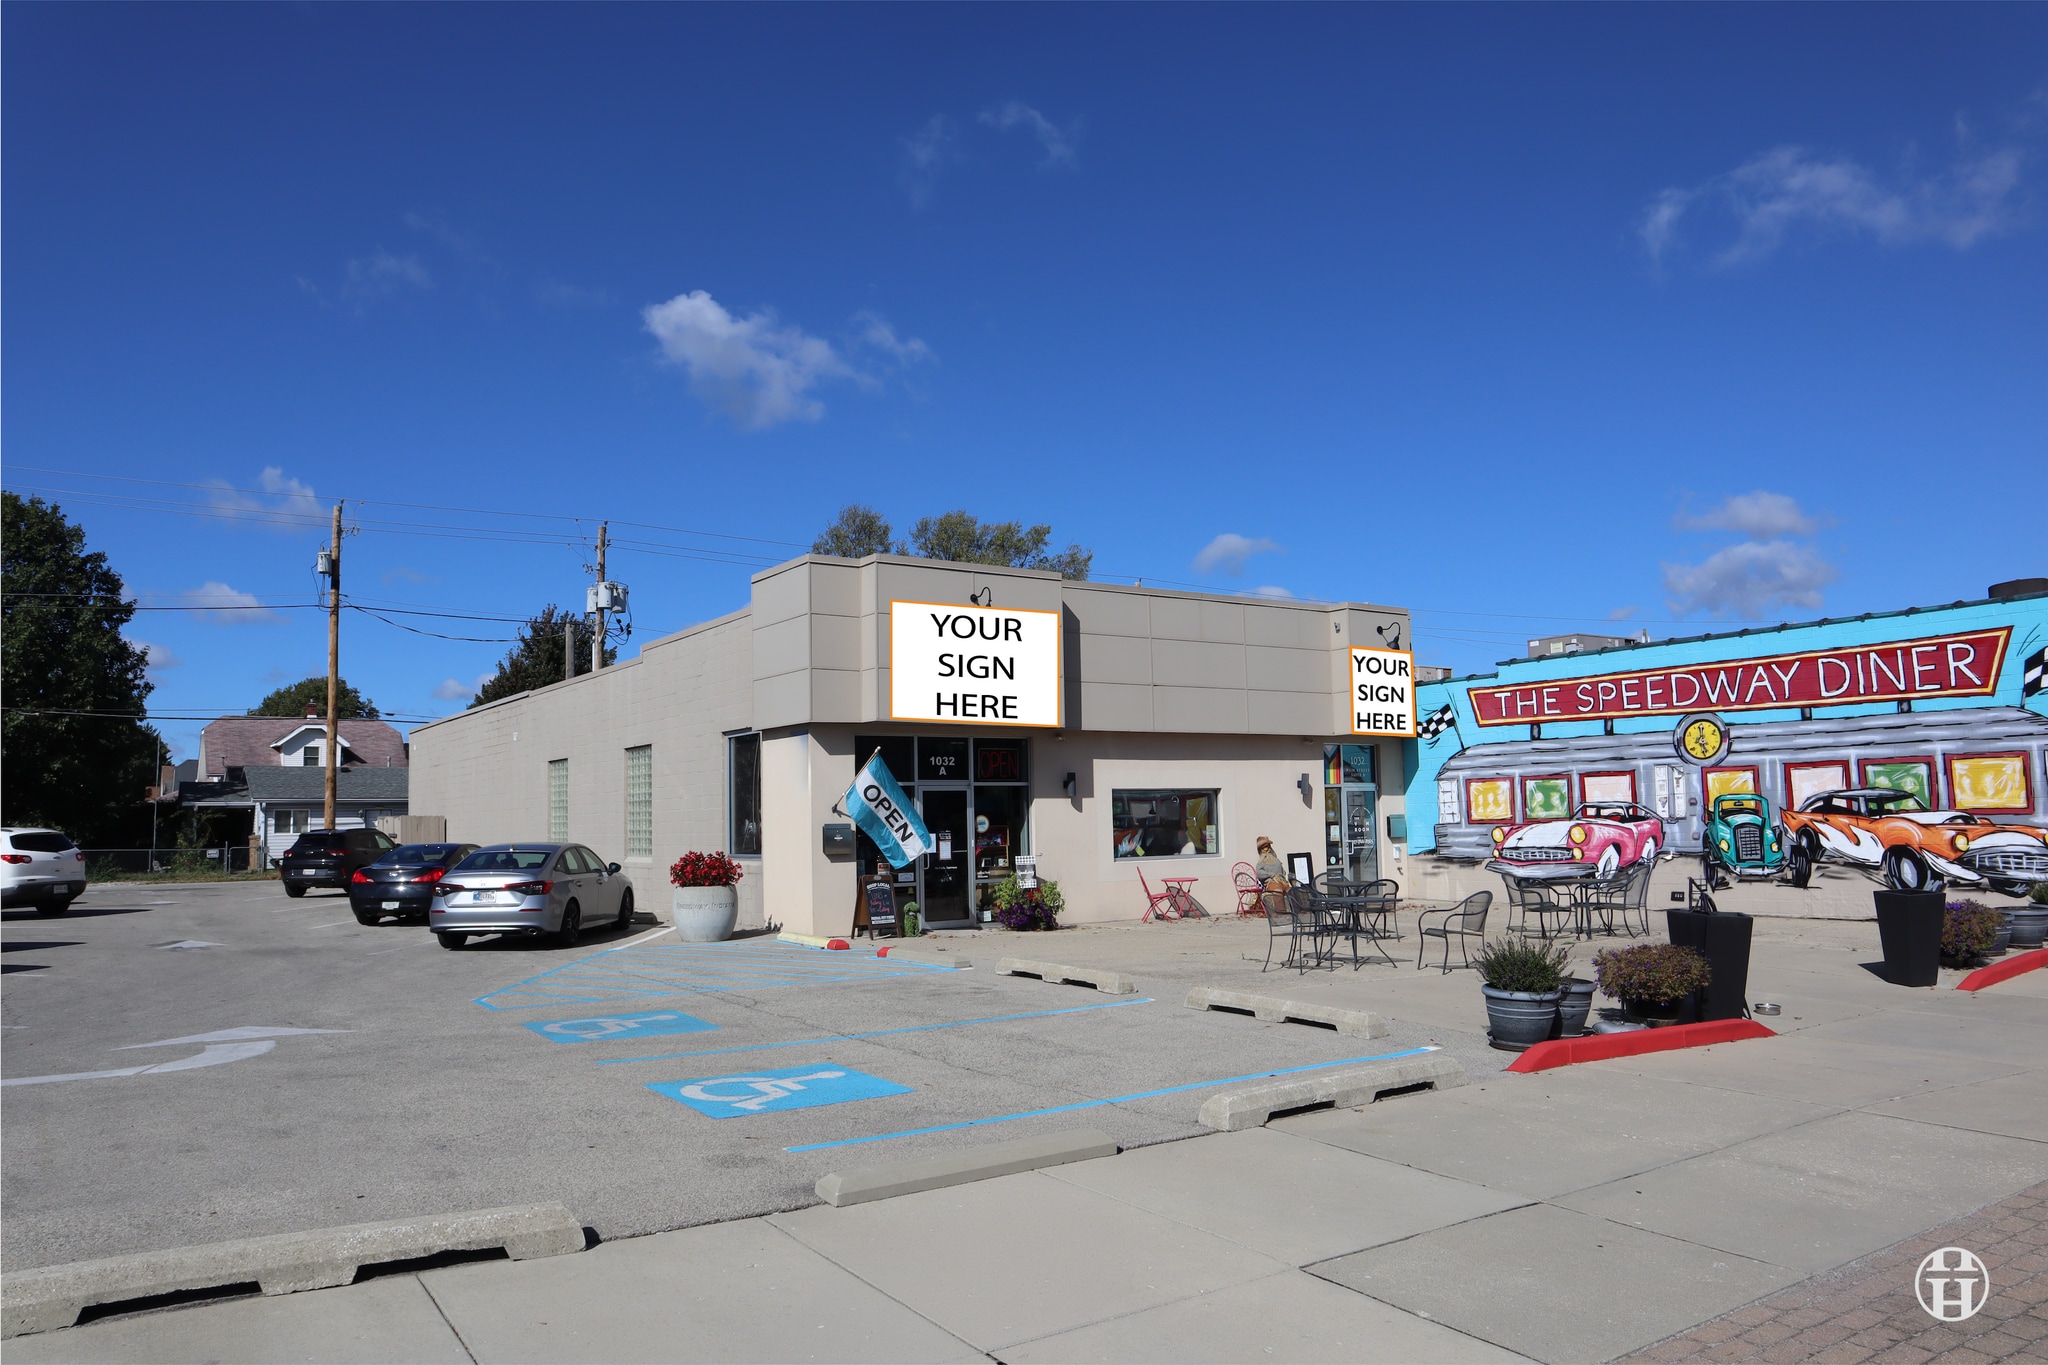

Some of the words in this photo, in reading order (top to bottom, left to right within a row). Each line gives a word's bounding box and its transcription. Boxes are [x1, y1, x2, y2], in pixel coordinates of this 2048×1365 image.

[930, 613, 1022, 642] YOUR
[938, 653, 1014, 680] SIGN
[1353, 655, 1410, 677] YOUR
[1494, 687, 1562, 717] THE
[1576, 661, 1801, 713] SPEEDWAY
[1818, 643, 1983, 698] DINER
[936, 692, 1019, 719] HERE
[1358, 684, 1404, 703] SIGN
[1357, 712, 1406, 730] HERE
[929, 756, 955, 766] 1032
[939, 767, 947, 776] A
[980, 751, 1018, 778] OPEN
[1350, 756, 1365, 765] 1032
[863, 784, 914, 843] OPEN
